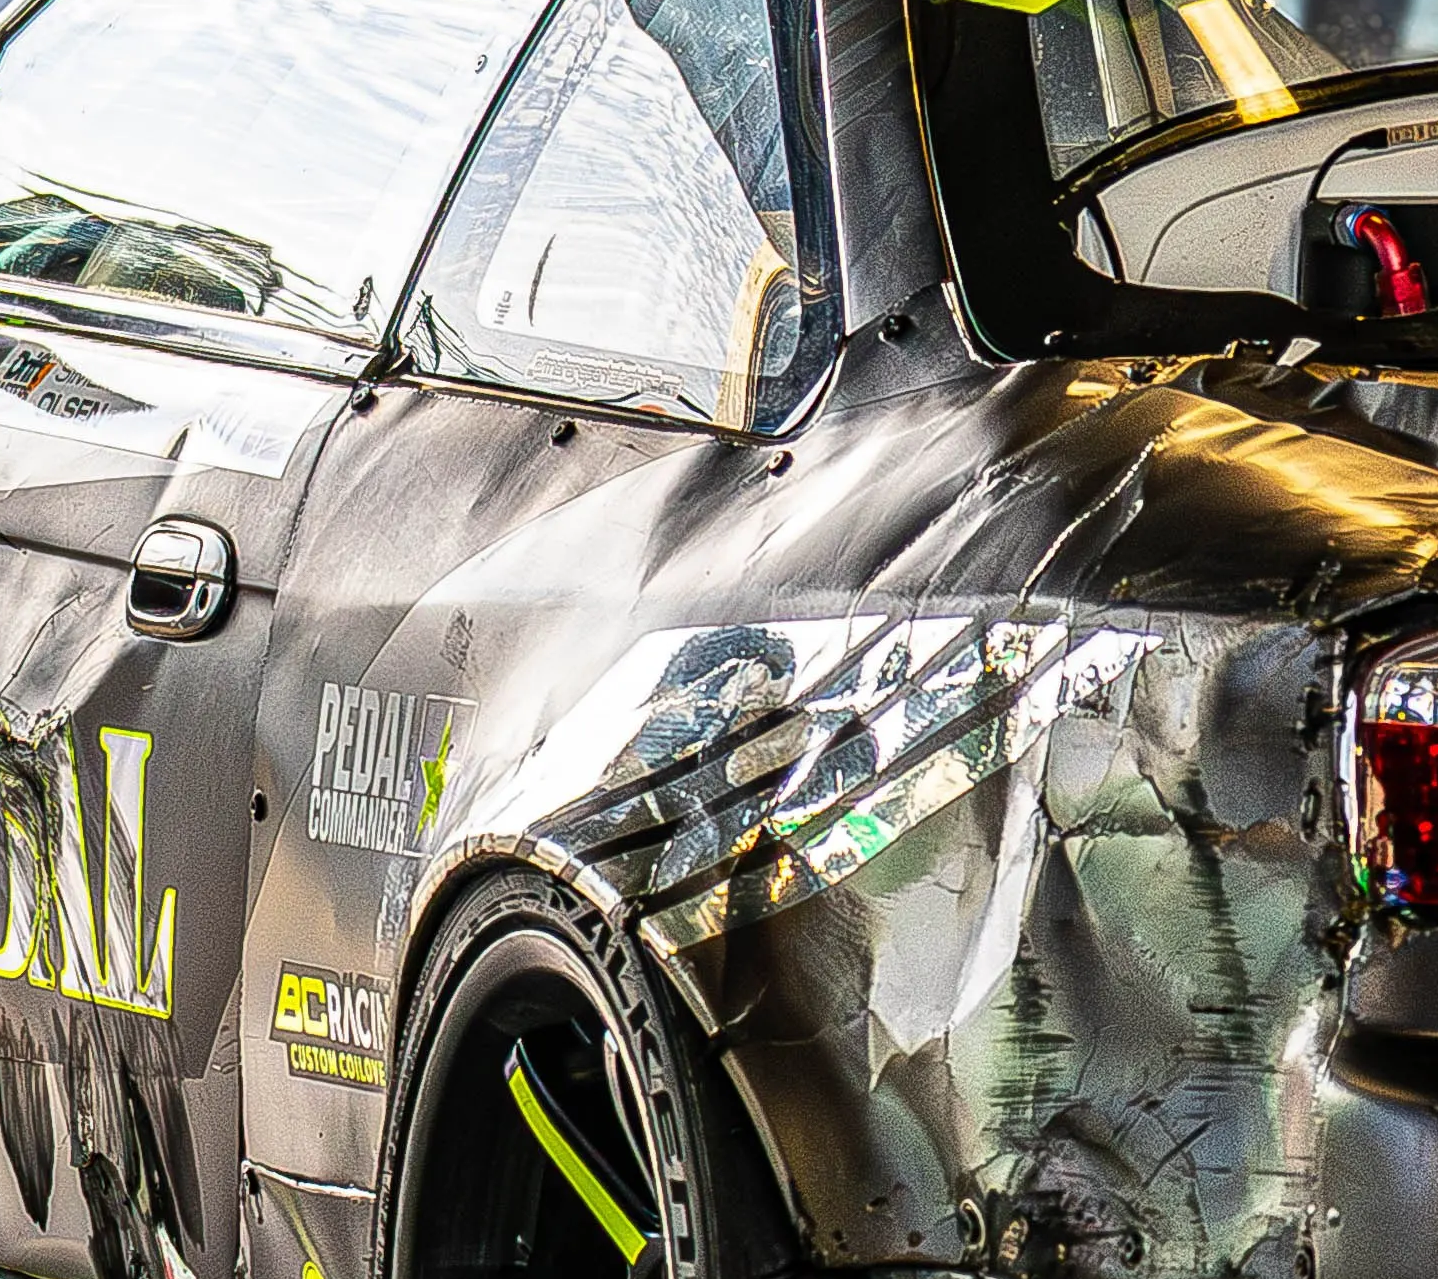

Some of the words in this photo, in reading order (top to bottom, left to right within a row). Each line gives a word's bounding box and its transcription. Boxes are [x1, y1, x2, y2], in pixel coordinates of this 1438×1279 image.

[312, 681, 416, 801] PEDAL
[308, 787, 409, 855] COMMANDER
[290, 1043, 338, 1075] CUSTOM
